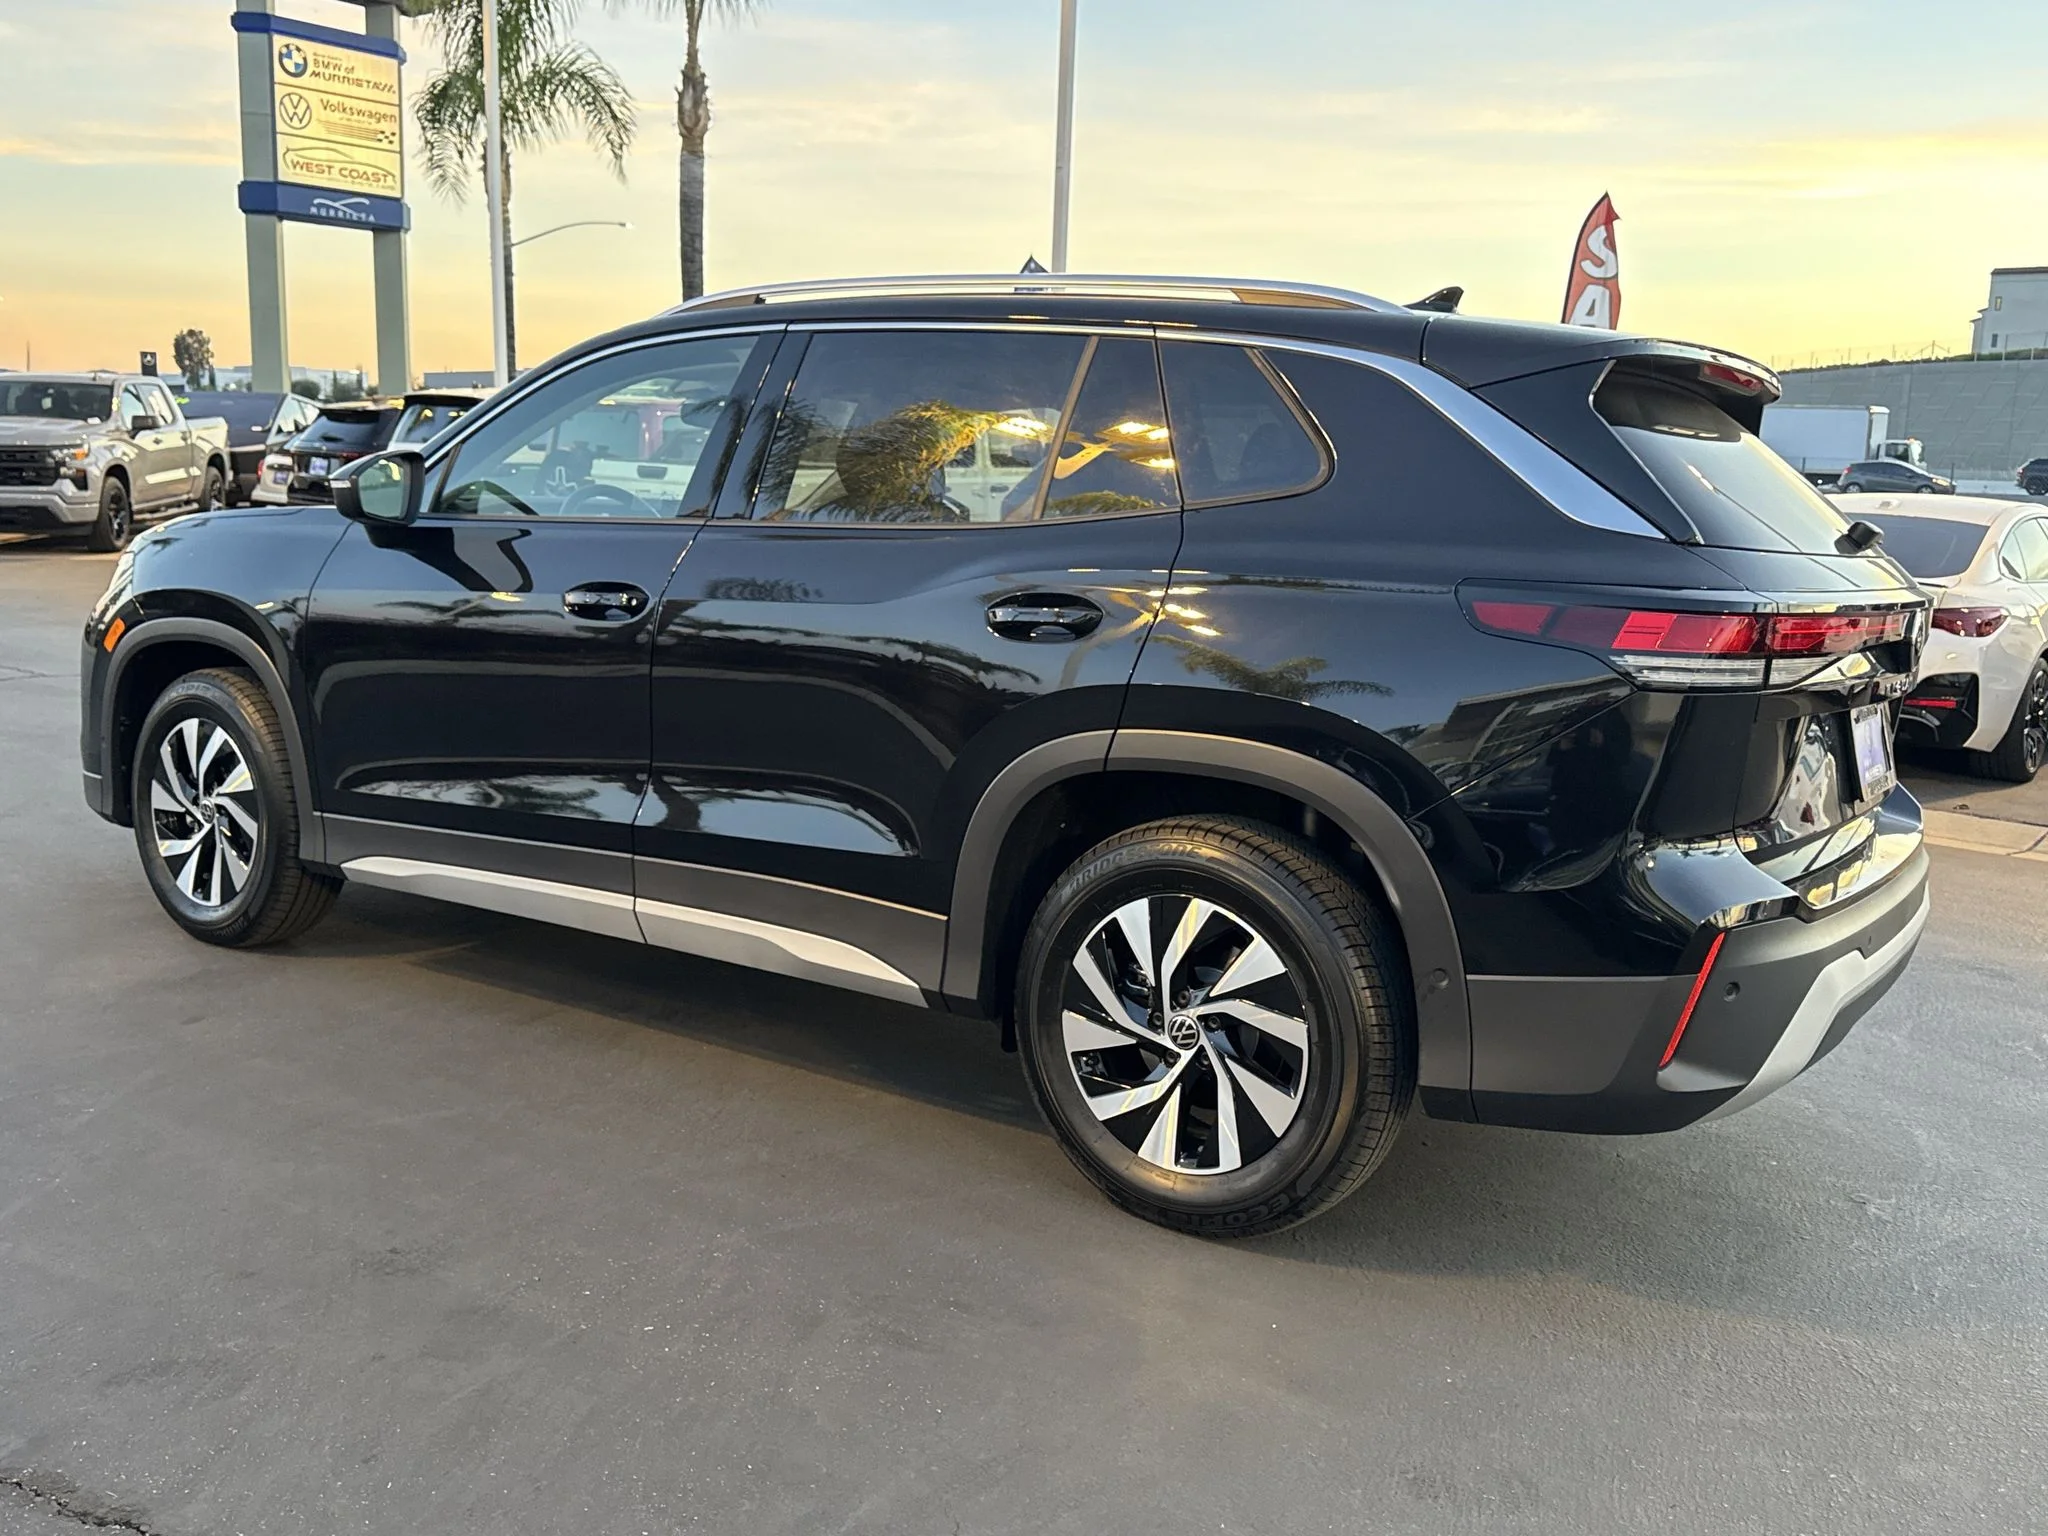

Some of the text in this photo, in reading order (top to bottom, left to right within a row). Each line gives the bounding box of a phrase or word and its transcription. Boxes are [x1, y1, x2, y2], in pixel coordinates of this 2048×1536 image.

[313, 58, 355, 75] BMW of
[320, 98, 397, 123] Volkswagen
[291, 158, 334, 176] WEST
[338, 166, 389, 184] COAST
